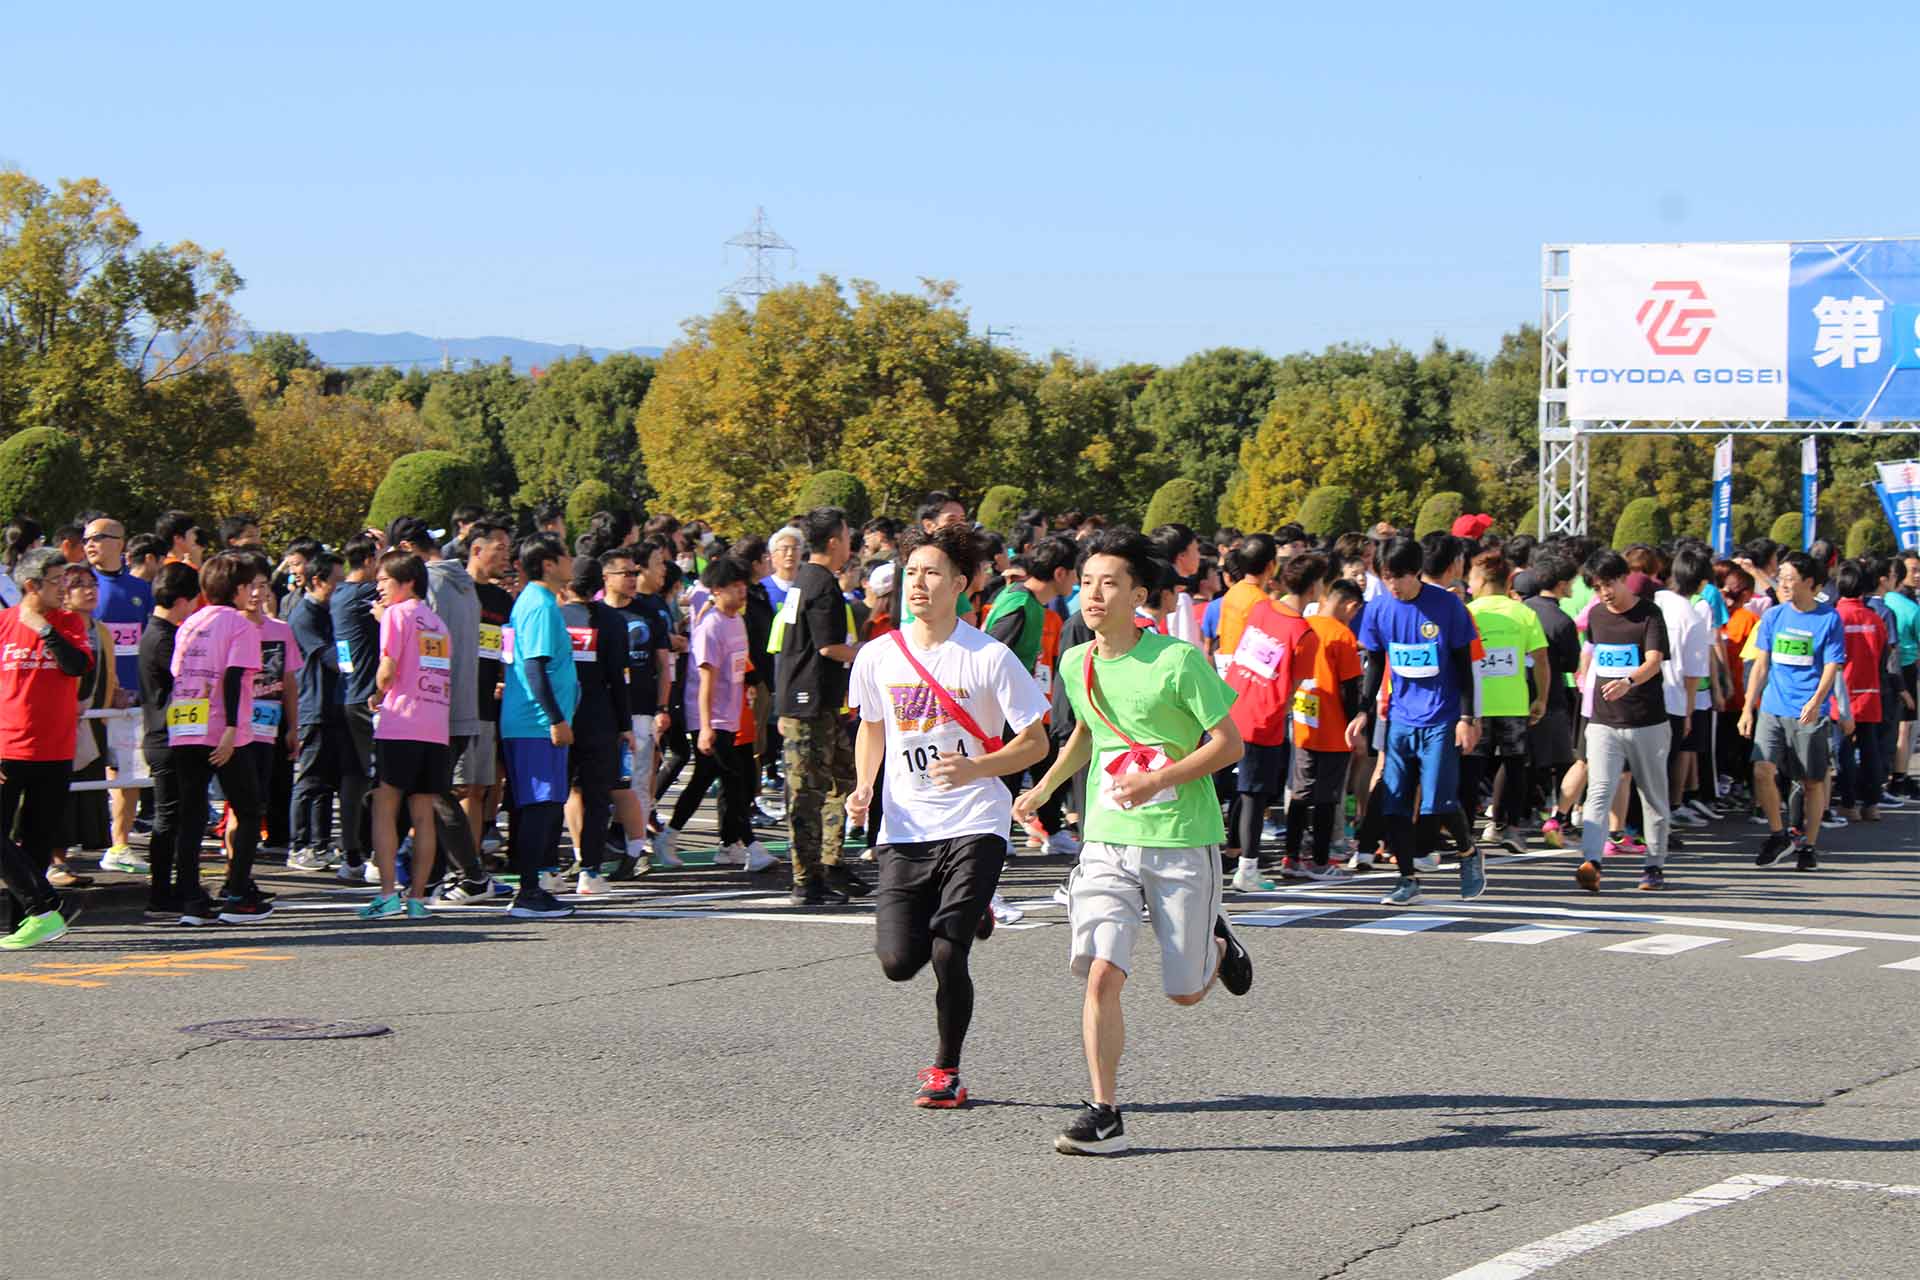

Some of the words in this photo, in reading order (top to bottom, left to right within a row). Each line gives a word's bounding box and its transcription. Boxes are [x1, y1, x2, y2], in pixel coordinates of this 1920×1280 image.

[1575, 369, 1685, 384] TOYODA
[1694, 369, 1783, 384] GOSEI
[114, 630, 137, 645] 2-5
[1778, 640, 1809, 656] 17-3
[1395, 651, 1432, 666] 12-2
[1599, 652, 1632, 666] 68-2
[174, 707, 198, 724] 9-6
[902, 739, 969, 773] 1034
